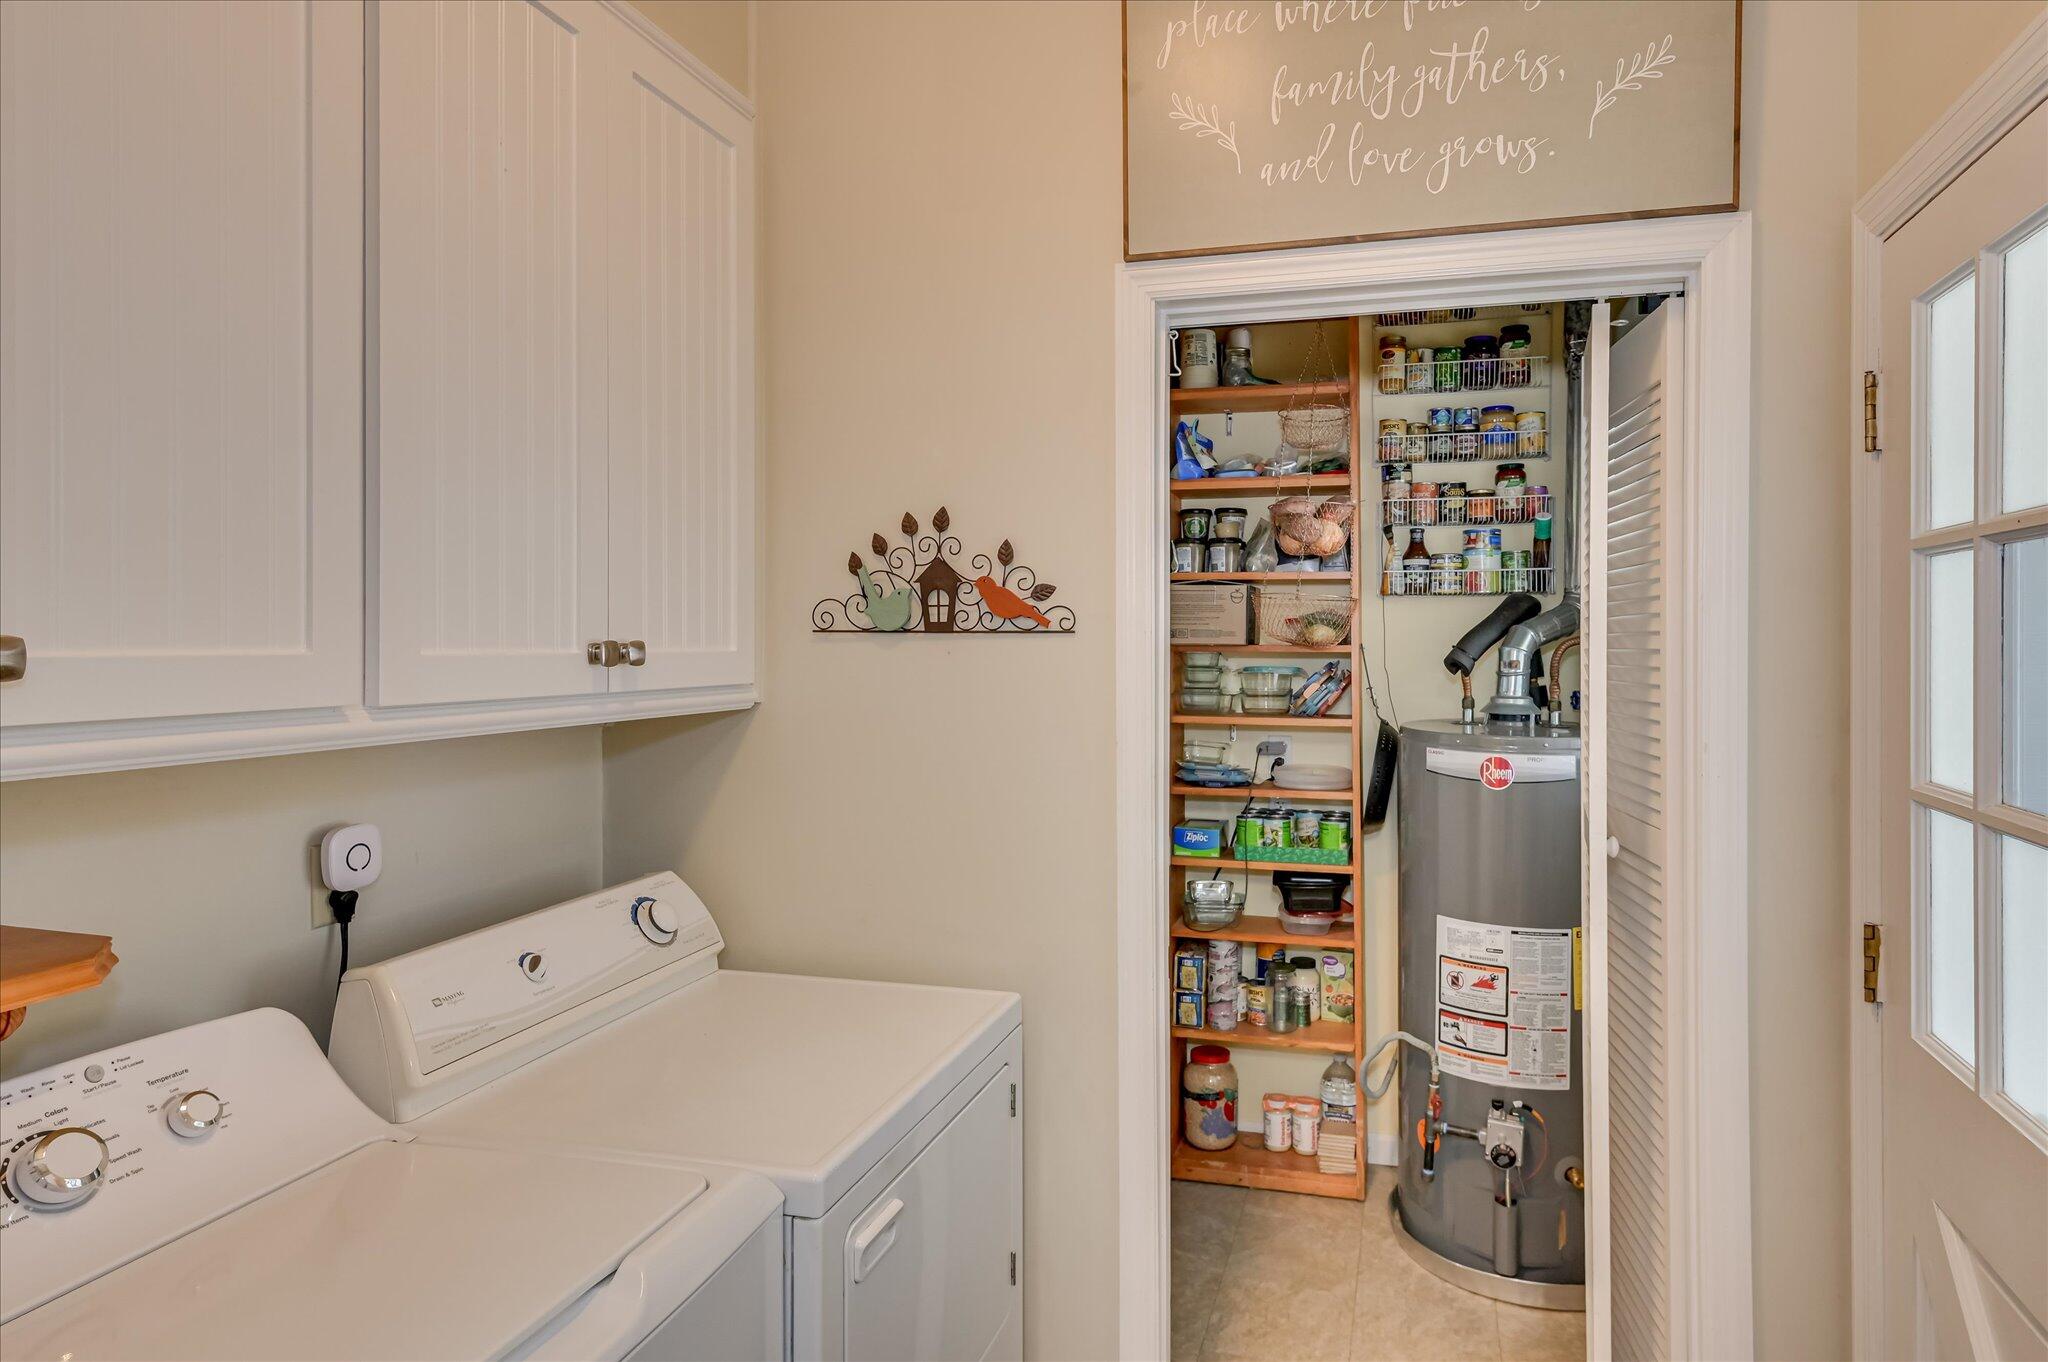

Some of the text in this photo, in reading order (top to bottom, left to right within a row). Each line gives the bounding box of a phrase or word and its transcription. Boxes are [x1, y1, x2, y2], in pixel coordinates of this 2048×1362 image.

[1157, 0, 1262, 69] place
[1271, 26, 1566, 125] family gathers,
[1260, 122, 1556, 194] and love grows.
[1483, 757, 1512, 783] Rheem
[1186, 831, 1208, 842] Ziploc
[147, 1068, 189, 1087] Temperature
[44, 1106, 68, 1118] Colors
[17, 1118, 42, 1130] Medium
[54, 1117, 69, 1126] Light
[127, 1147, 142, 1157] Wash
